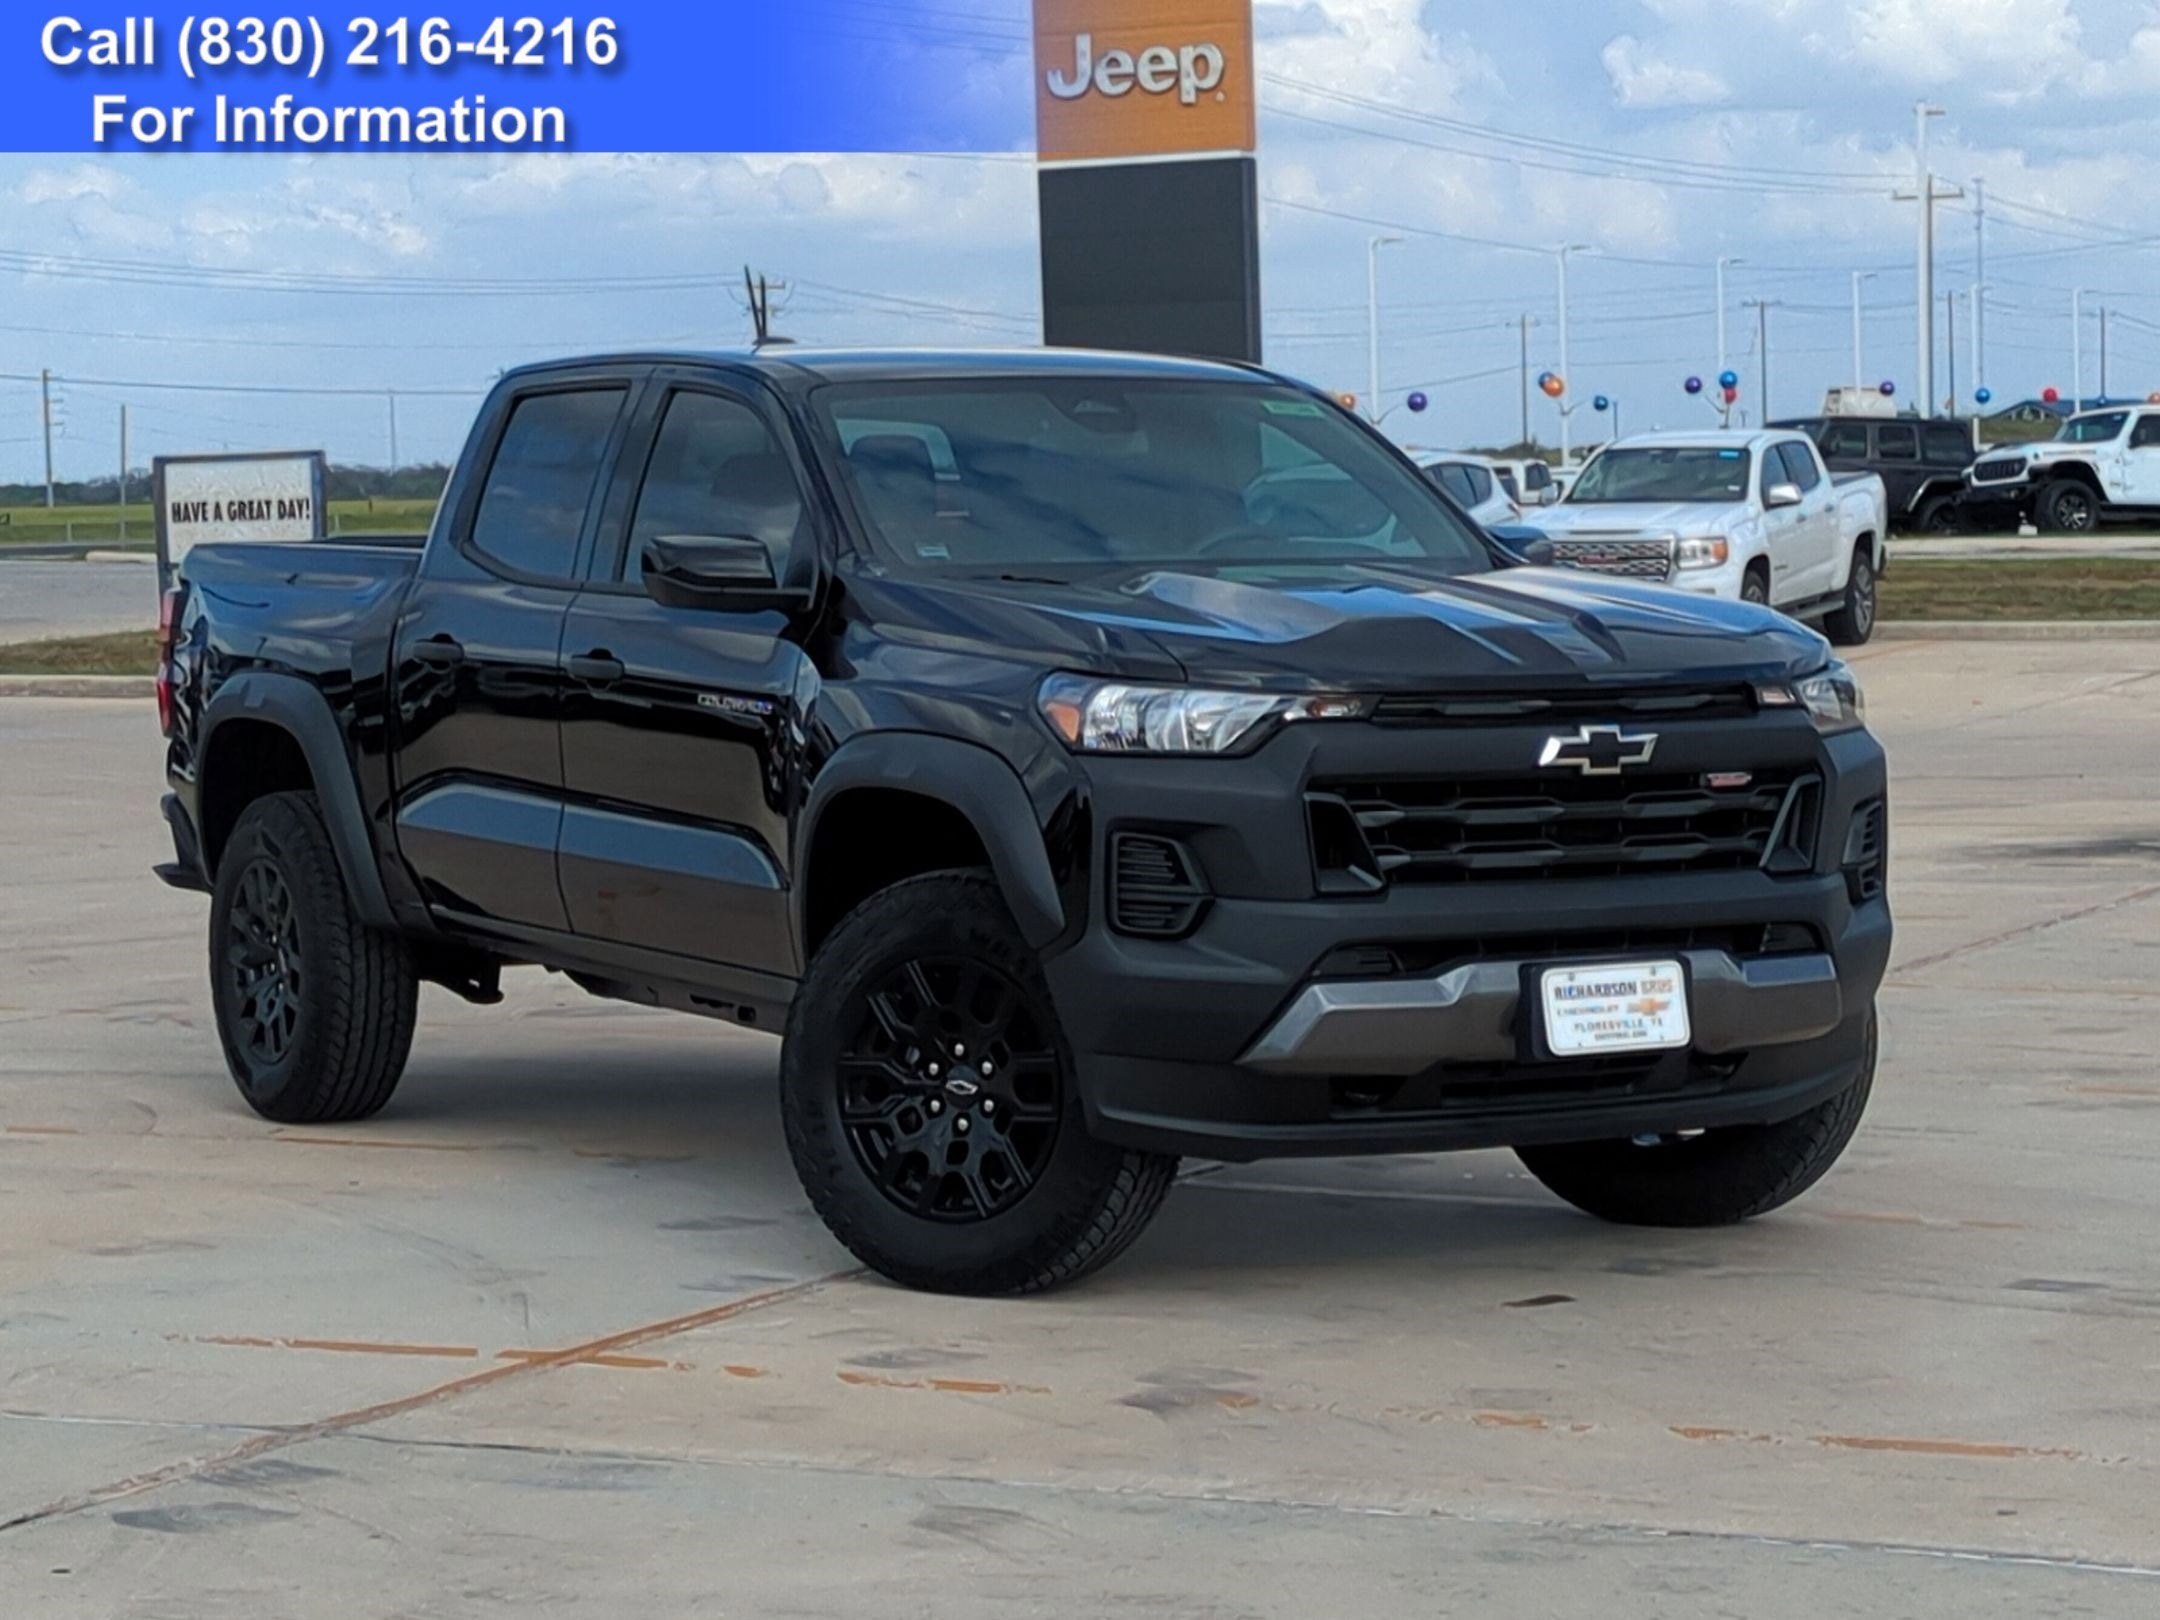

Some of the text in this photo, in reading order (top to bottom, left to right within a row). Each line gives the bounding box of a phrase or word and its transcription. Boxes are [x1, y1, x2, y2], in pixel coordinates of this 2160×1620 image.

[1047, 33, 1224, 104] Jeep
[171, 498, 310, 523] HAVE A GREAT DAY!
